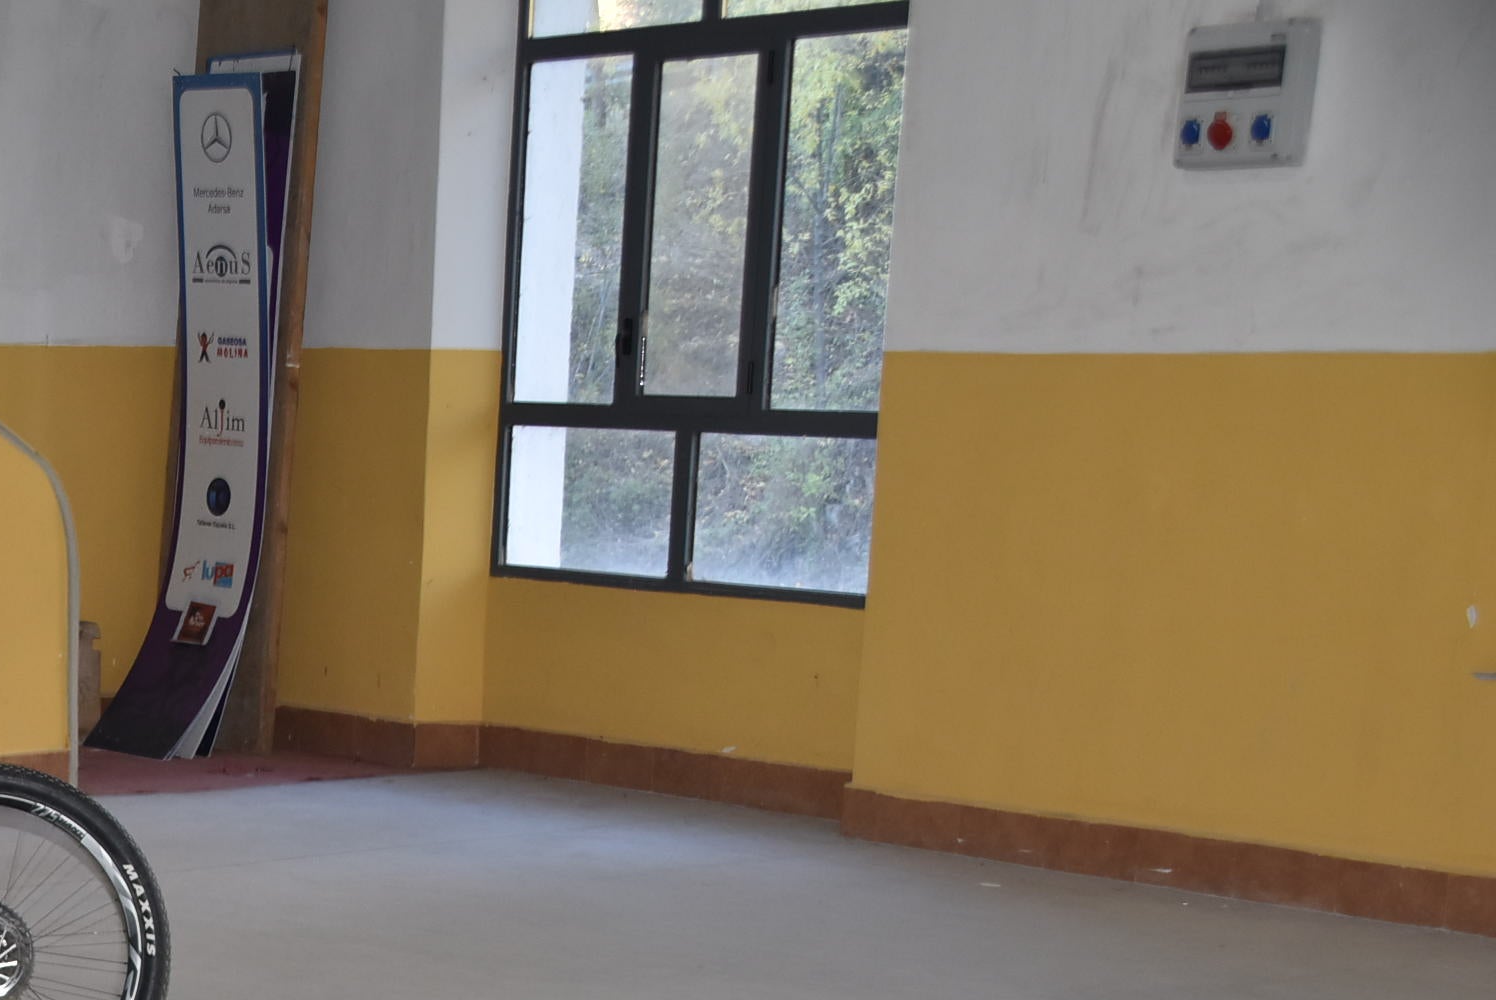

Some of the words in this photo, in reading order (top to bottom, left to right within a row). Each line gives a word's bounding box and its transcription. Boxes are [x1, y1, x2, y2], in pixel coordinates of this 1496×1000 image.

[193, 186, 244, 199] Mercedes-Benz
[216, 347, 248, 359] MOLINA
[122, 863, 157, 957] MAXXIS
